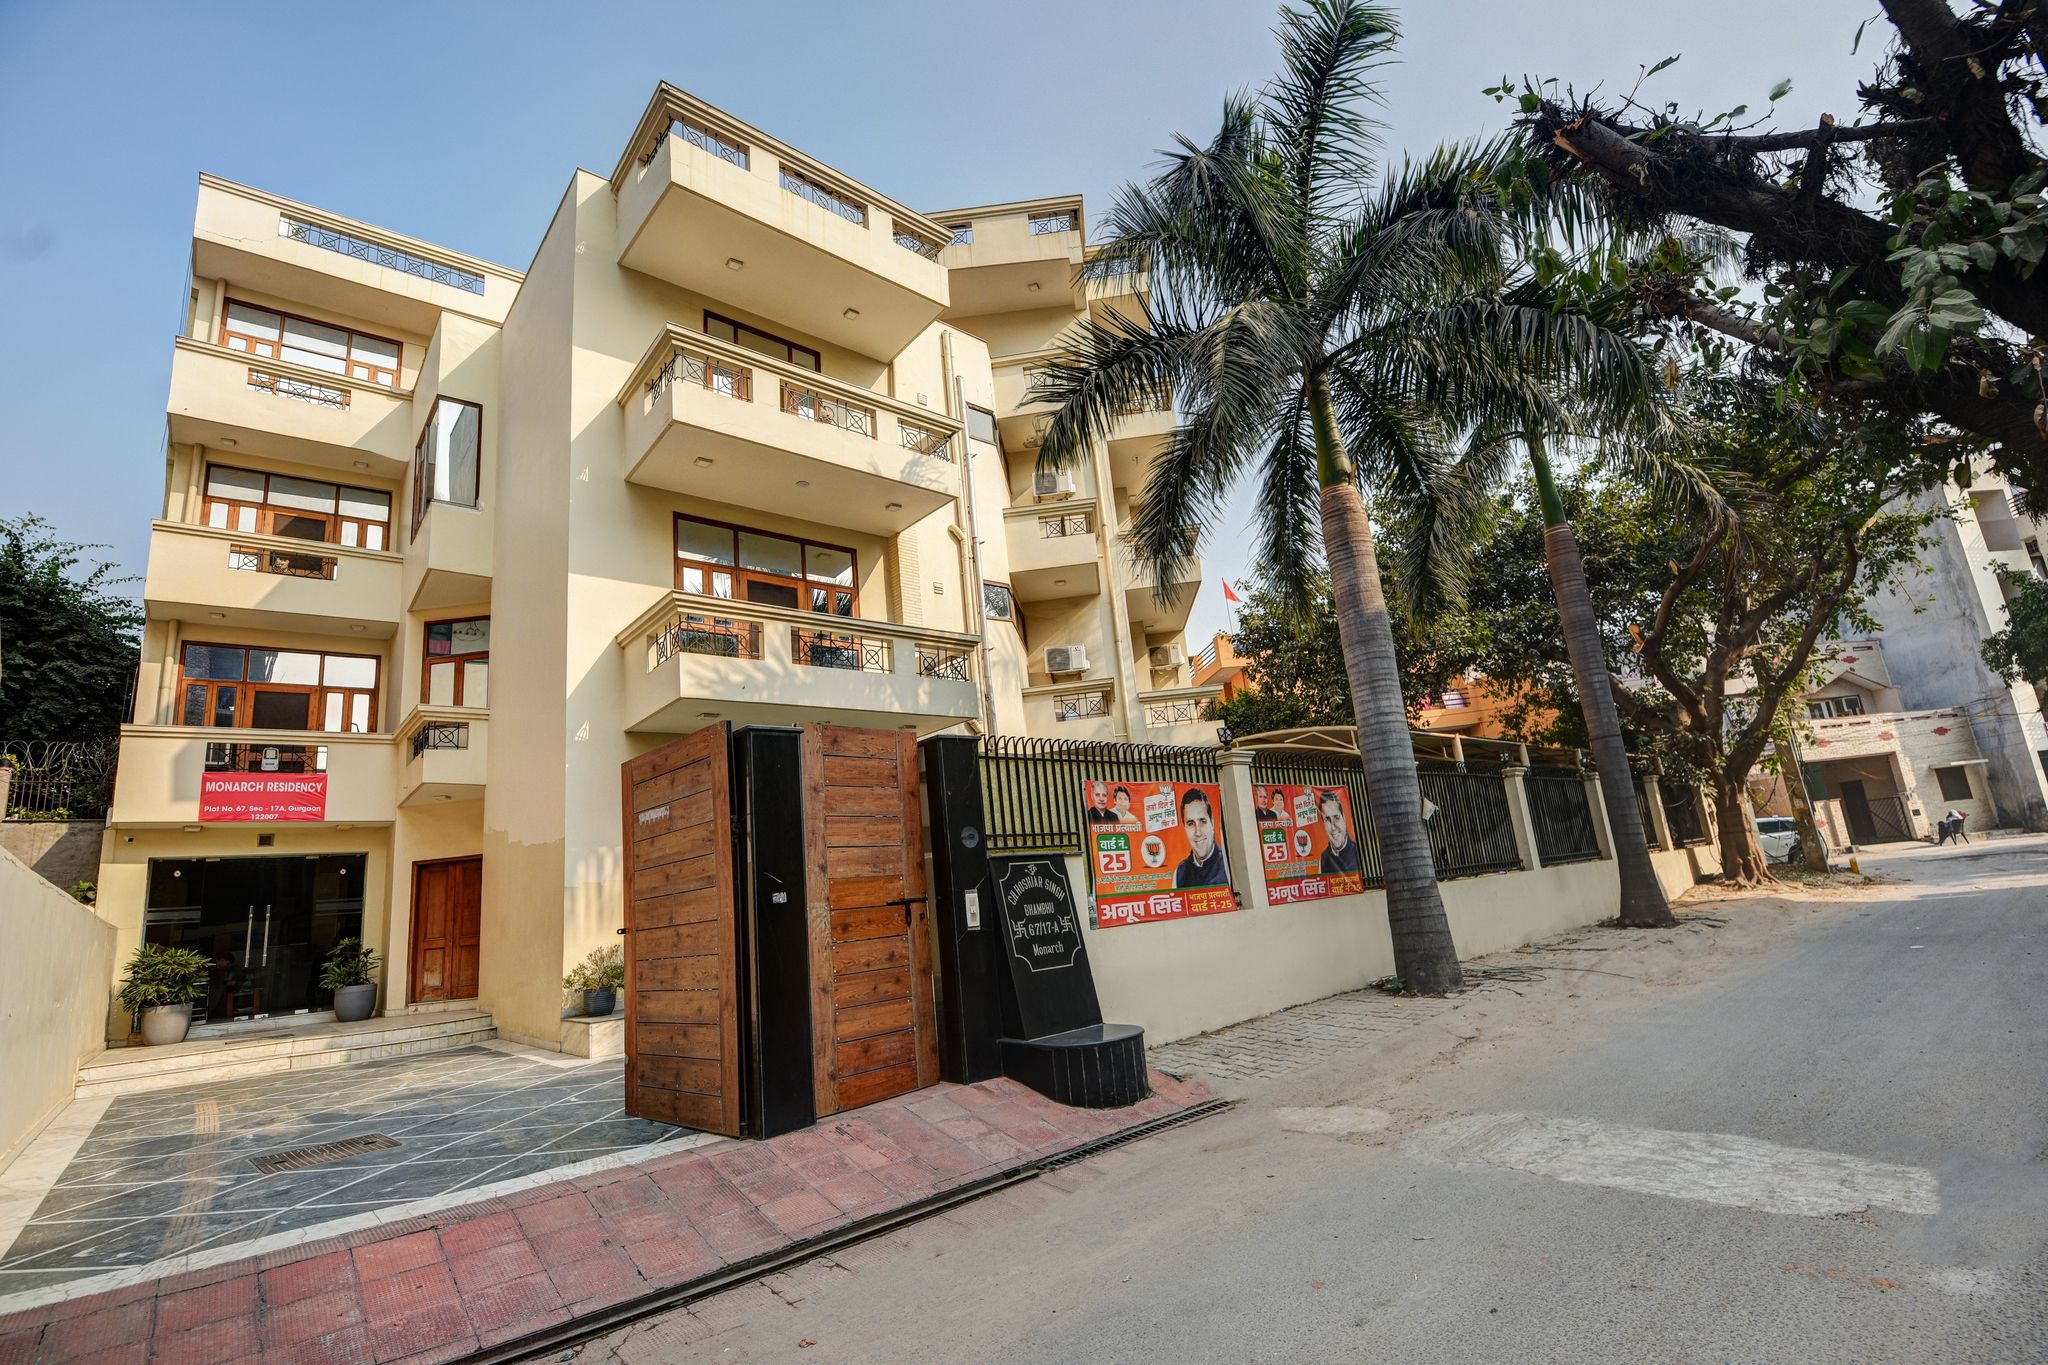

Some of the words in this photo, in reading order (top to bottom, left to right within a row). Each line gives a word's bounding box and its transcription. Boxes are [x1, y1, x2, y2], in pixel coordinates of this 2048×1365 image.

[206, 782, 263, 792] MONARCH
[267, 782, 322, 792] RESIDENCY
[204, 805, 220, 813] Plot
[288, 805, 321, 813] Gurgaon
[1099, 837, 1117, 850] वार्ड
[1267, 845, 1285, 860] 25
[1103, 853, 1127, 871] 25
[1044, 878, 1066, 902] SINGH
[1268, 884, 1299, 903] अनूप
[1301, 877, 1325, 896] सिंह
[1100, 901, 1145, 923] अनूप
[1148, 893, 1182, 915] सिंह
[1191, 900, 1208, 912] वार्ड
[1028, 921, 1060, 937] 67/17-A
[1032, 941, 1064, 957] Monarch
